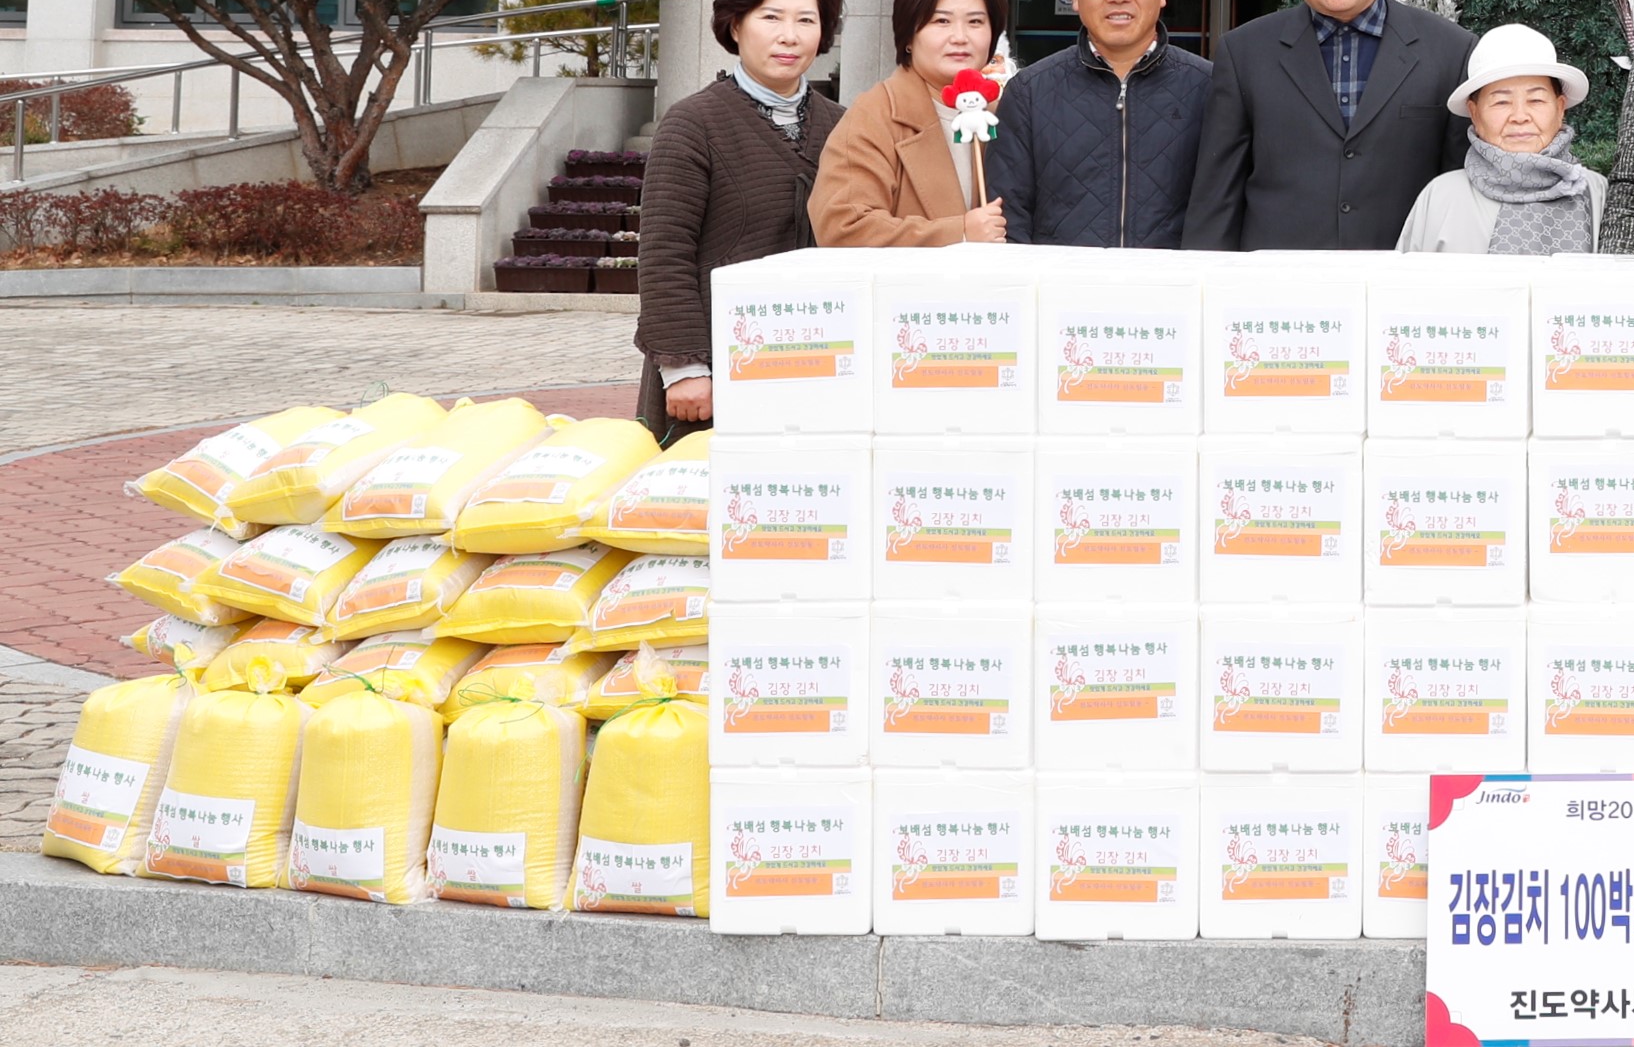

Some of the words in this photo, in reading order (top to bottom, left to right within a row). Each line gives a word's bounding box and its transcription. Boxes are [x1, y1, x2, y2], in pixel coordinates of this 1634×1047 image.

[734, 304, 768, 319] 보배섬
[822, 300, 845, 314] 행사
[772, 328, 796, 343] 김장
[800, 326, 824, 341] 김치
[1231, 321, 1264, 335] 보배섬
[1319, 320, 1342, 334] 행사
[1268, 346, 1291, 360] 김장
[1296, 345, 1320, 360] 김치
[1557, 478, 1590, 491] 보배섬
[894, 486, 927, 499] 보배섬
[983, 488, 1005, 501] 행사
[1594, 503, 1617, 517] 김장
[931, 512, 954, 526] 김장
[959, 512, 983, 526] 김치
[730, 657, 763, 671] 보배섬
[818, 656, 841, 669] 행사
[1390, 658, 1423, 672] 보배섬
[1478, 658, 1501, 671] 행사
[768, 682, 790, 696] 김장
[795, 681, 819, 696] 김치
[1427, 683, 1450, 698] 김장
[1455, 683, 1479, 697] 김치
[114, 772, 135, 787] 행사
[1475, 791, 1521, 804] Jindo
[221, 812, 243, 826] 행사
[732, 820, 766, 834] 보배섬
[821, 818, 844, 832] 행사
[1058, 825, 1092, 838] 보배섬
[1148, 826, 1170, 839] 행사
[1388, 822, 1422, 835] 보배섬
[353, 840, 375, 853] 행사
[494, 845, 516, 858] 행사
[770, 845, 793, 860] 김장
[798, 844, 822, 859] 김치
[660, 855, 683, 869] 행사
[1096, 851, 1118, 865] 김장
[1124, 851, 1148, 865] 김치
[1449, 869, 1548, 945] 김장김치
